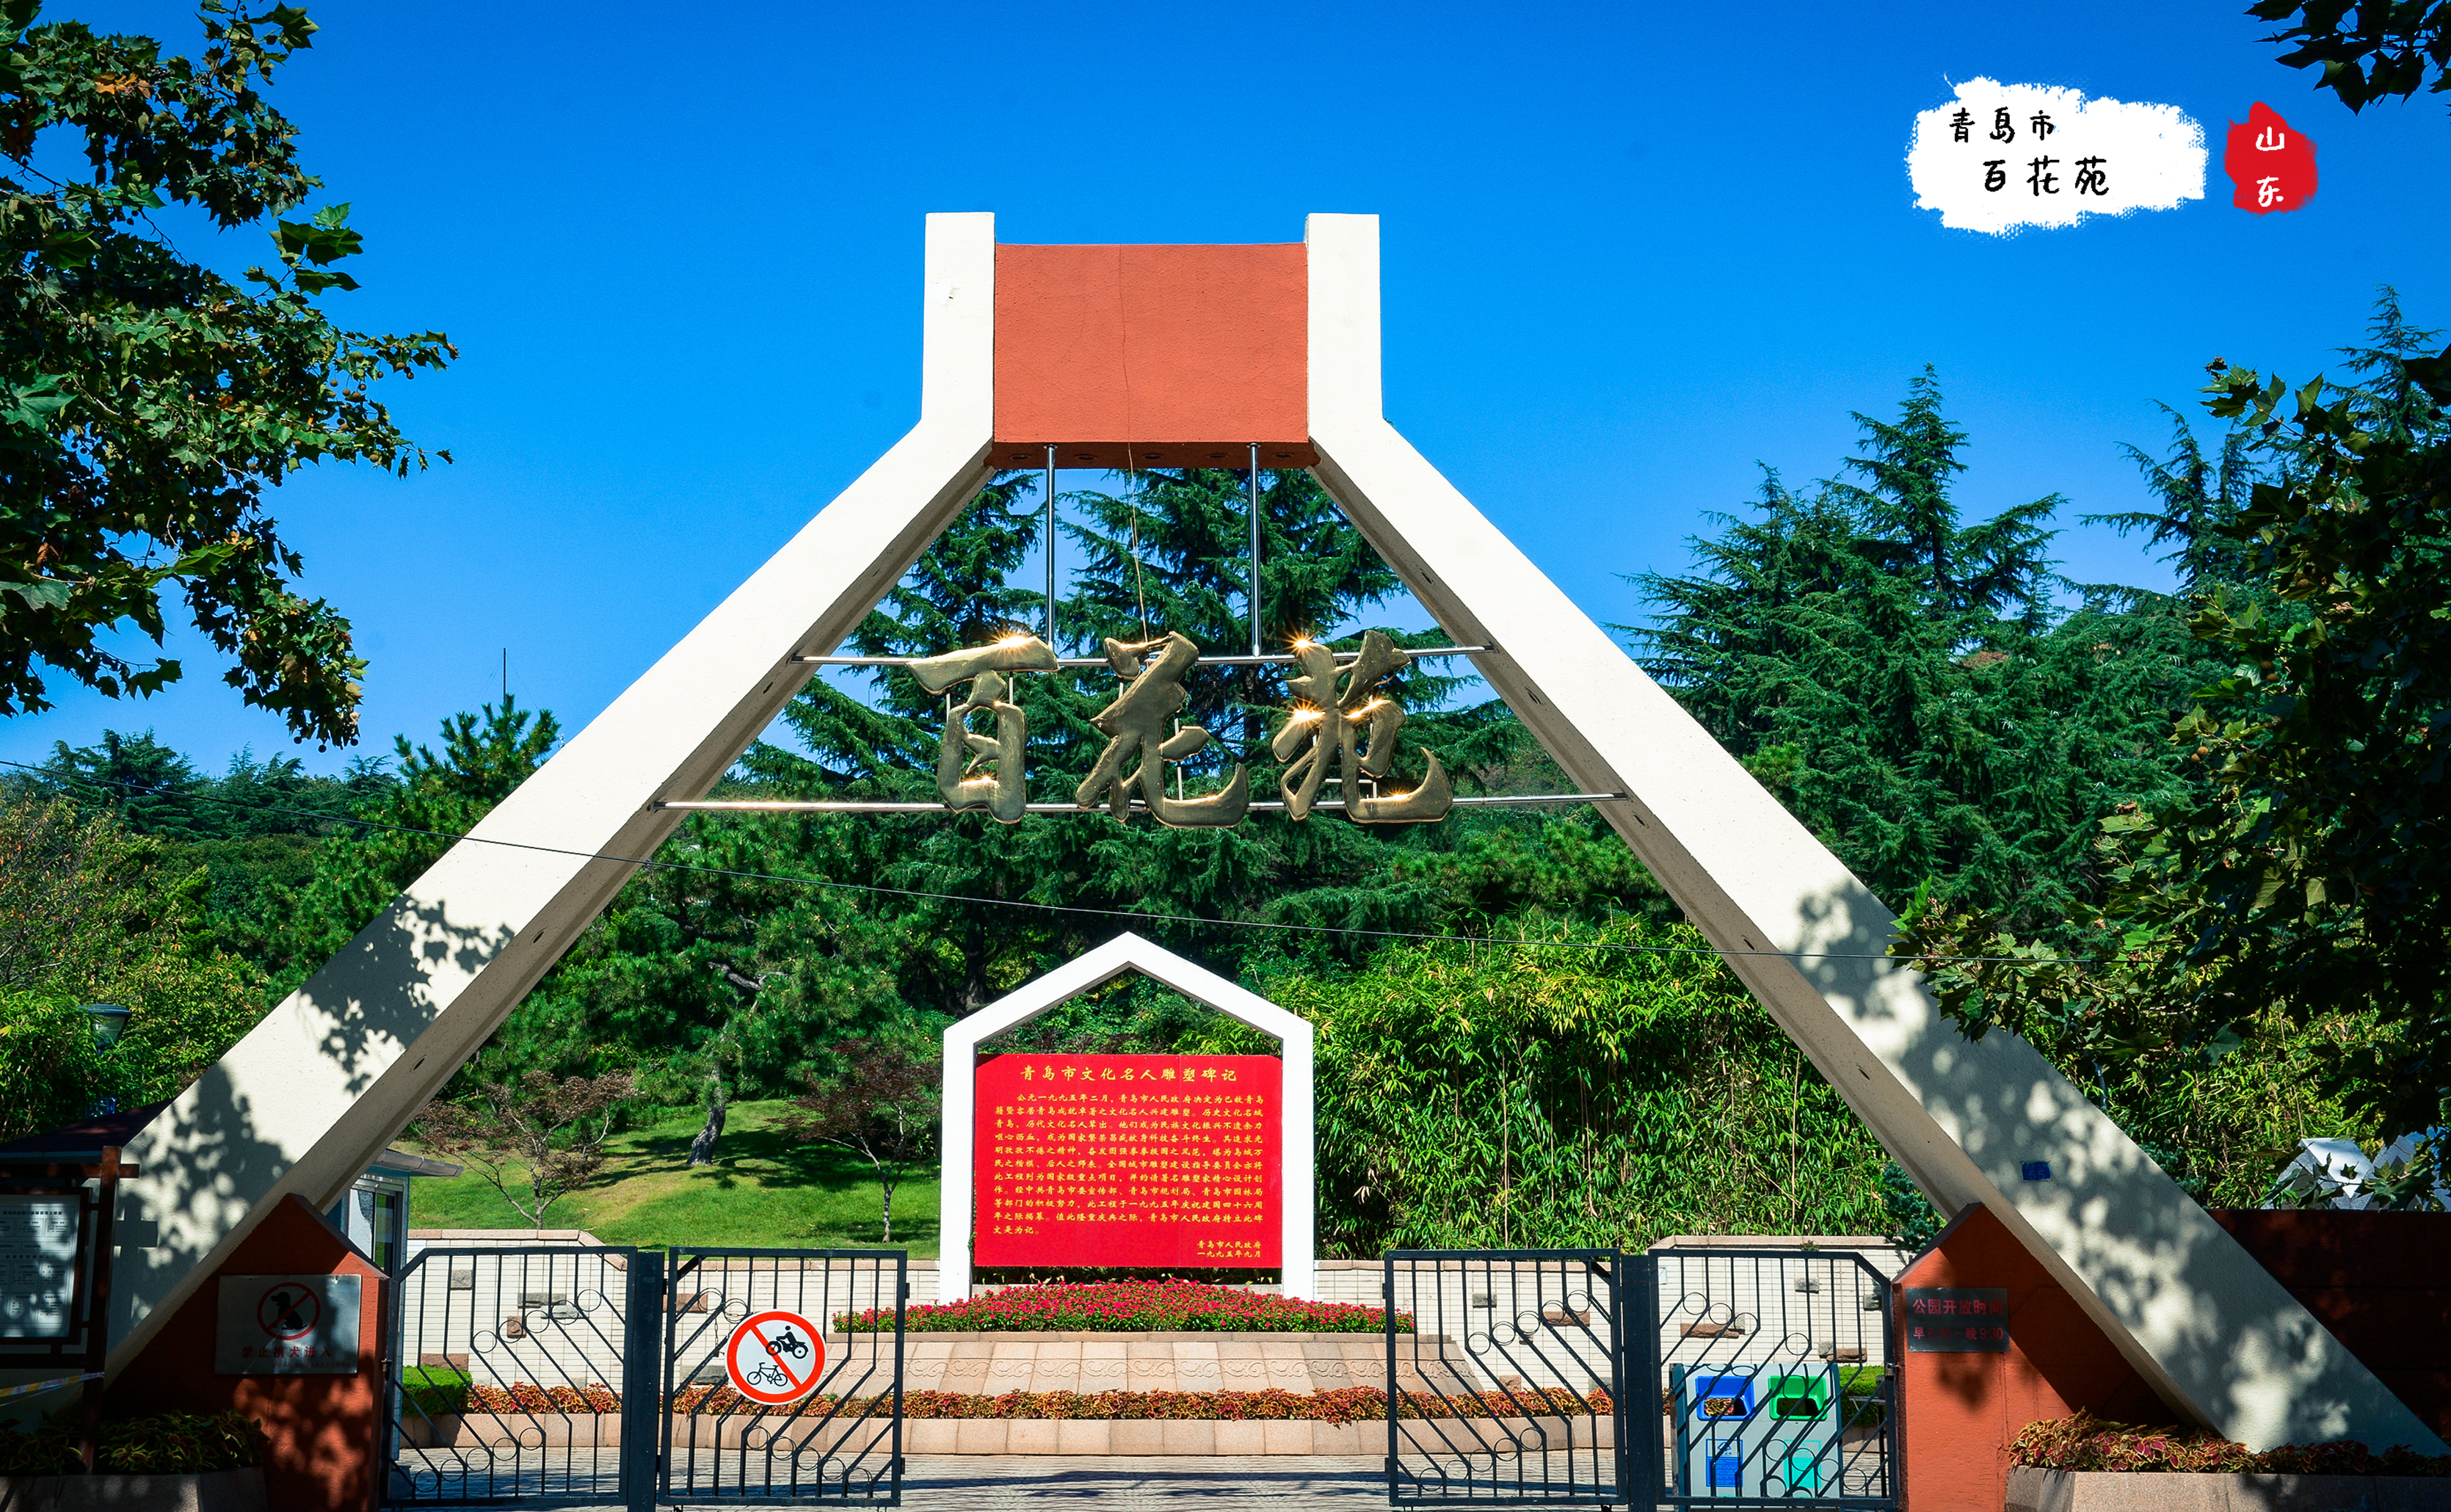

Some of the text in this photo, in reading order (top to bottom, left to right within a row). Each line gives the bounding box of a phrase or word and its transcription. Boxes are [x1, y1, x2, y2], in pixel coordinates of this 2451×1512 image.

[905, 630, 1453, 829] 百花苑
[1020, 1064, 1238, 1083] 青岛市文化名人雕塑碑记
[1197, 1240, 1262, 1249] 青岛市人民政府
[1197, 1249, 1261, 1259] 一九九五年九月
[1912, 1298, 2003, 1315] 公园开放时间
[242, 1345, 332, 1359] 禁止携犬进入
